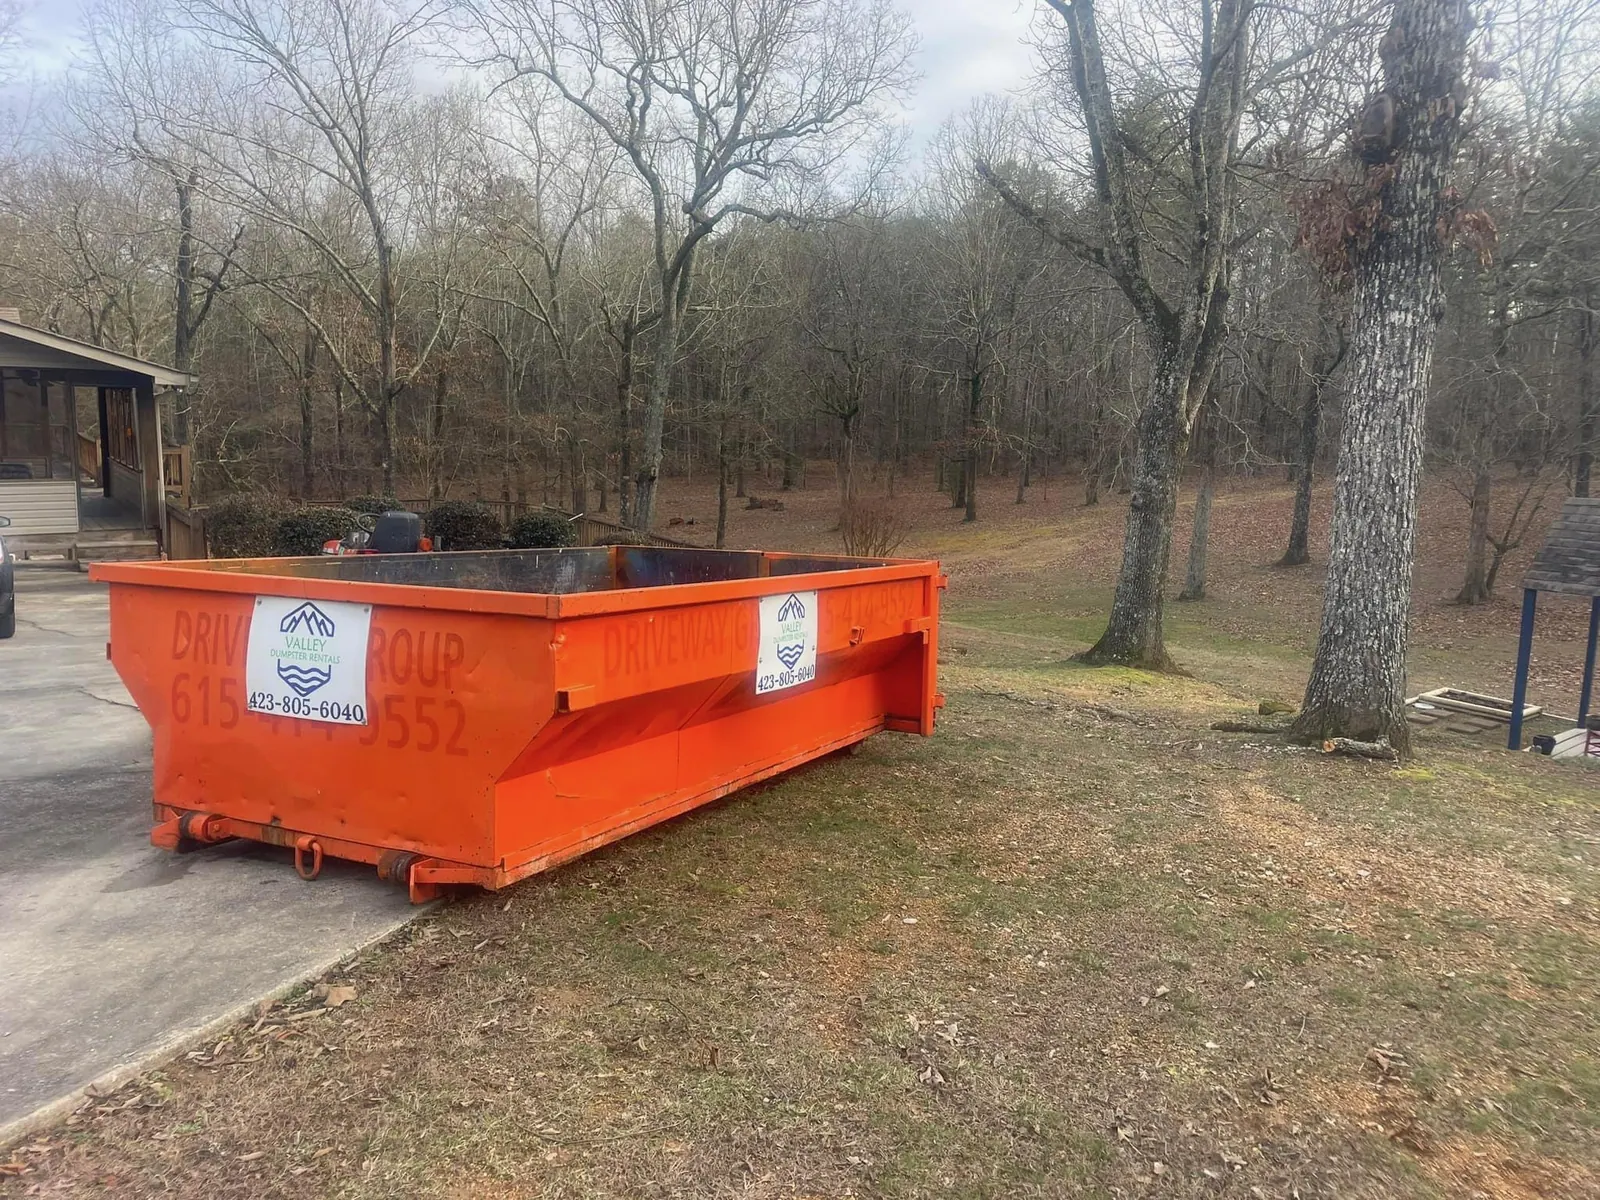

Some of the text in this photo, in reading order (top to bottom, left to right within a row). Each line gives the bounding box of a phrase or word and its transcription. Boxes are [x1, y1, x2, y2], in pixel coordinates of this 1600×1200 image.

[781, 621, 802, 634] VALLEY
[285, 636, 327, 653] VALLEY
[603, 606, 729, 679] DRIVEWAY
[270, 649, 341, 665] DUMPSTER RENTALS
[367, 627, 465, 690] ROUP
[757, 664, 815, 691] 423-805-6040
[248, 691, 365, 722] 423-805-6040
